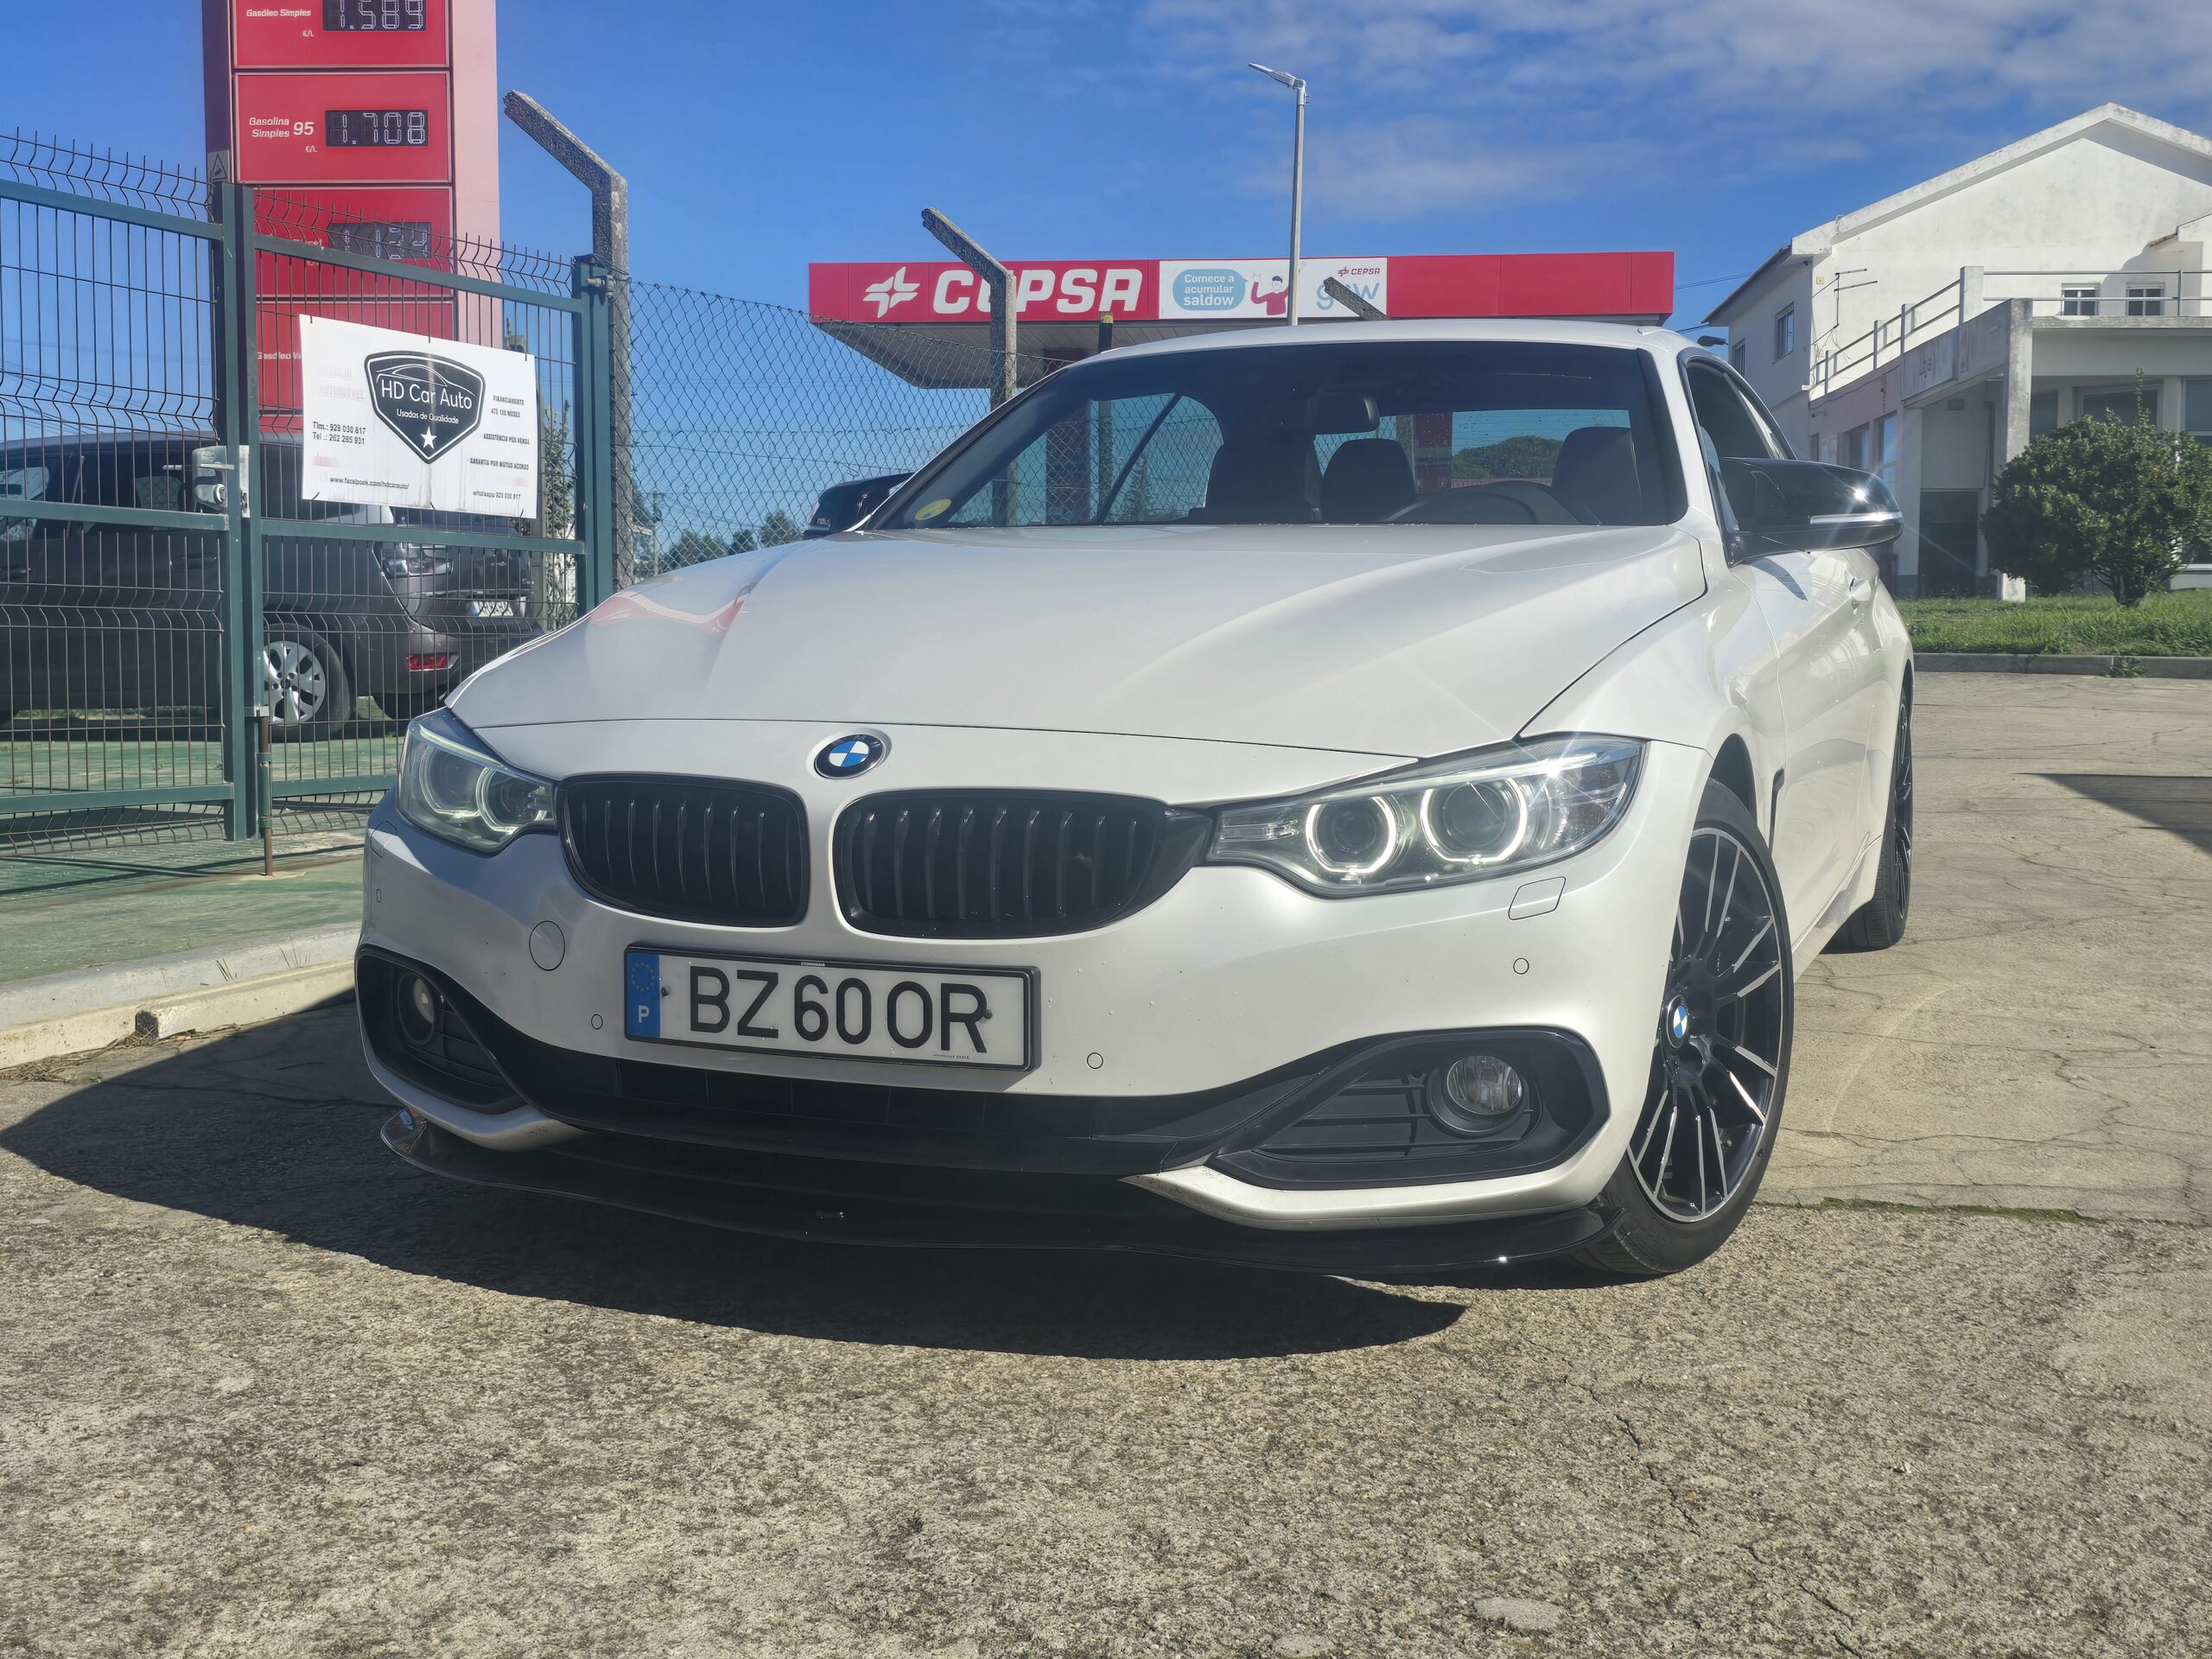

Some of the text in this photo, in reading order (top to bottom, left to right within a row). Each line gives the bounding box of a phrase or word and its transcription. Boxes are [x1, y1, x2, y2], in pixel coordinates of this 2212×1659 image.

[246, 9, 312, 18] Gasóleo Simples
[340, 0, 423, 30] 1.589
[249, 117, 289, 126] Gasolina
[293, 121, 315, 136] 95
[342, 111, 425, 144] 1.708
[251, 129, 290, 139] Simples
[1184, 274, 1235, 283] Comece a
[1184, 285, 1235, 294] acumular
[1183, 295, 1235, 307] saldow
[381, 378, 473, 410] HD Car Auto
[397, 408, 460, 424] Usados de Qualidade
[342, 424, 354, 434] 030
[354, 426, 366, 435] 817
[328, 434, 340, 442] 262
[354, 436, 365, 445] 931
[470, 457, 490, 466] GARANTIA
[638, 1005, 650, 1023] P
